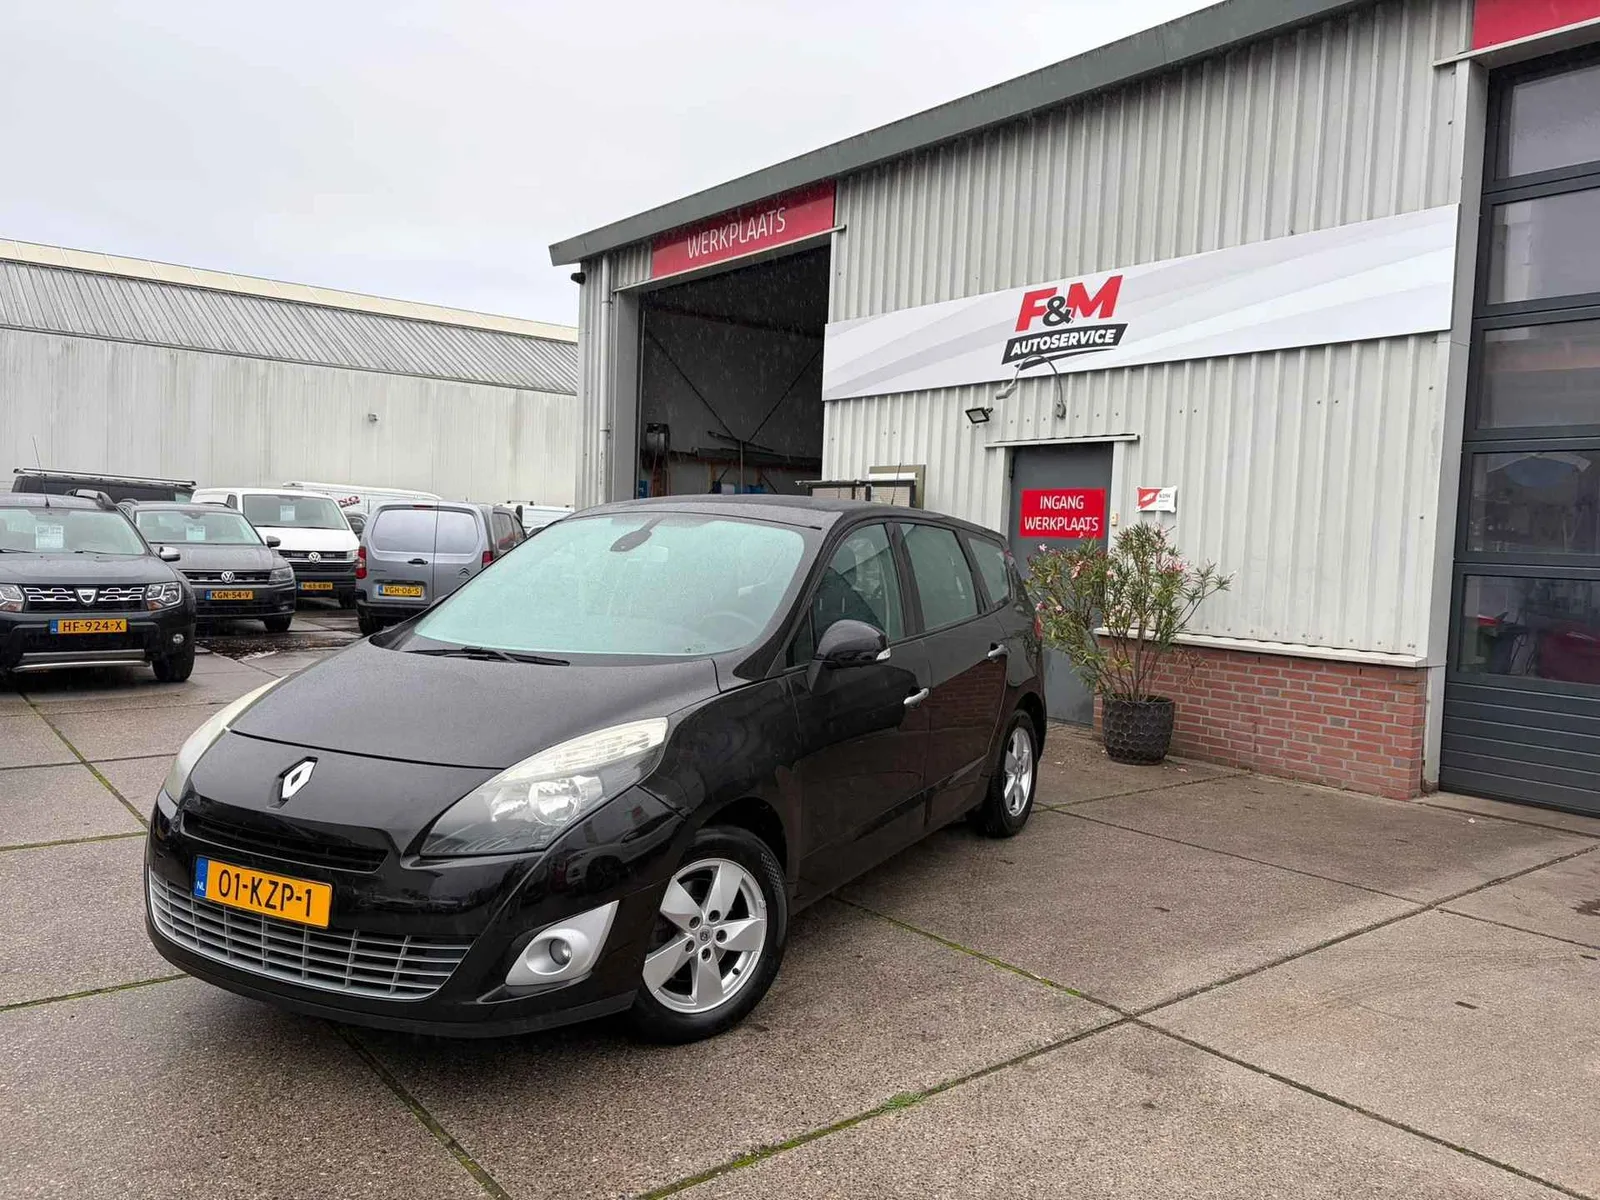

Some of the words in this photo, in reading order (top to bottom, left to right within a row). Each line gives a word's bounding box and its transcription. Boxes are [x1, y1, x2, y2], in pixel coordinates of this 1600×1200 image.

[687, 207, 786, 259] WERKPLAATS
[1014, 274, 1123, 332] F&M
[1010, 329, 1117, 356] AUTOSERVICE
[1040, 495, 1085, 510] INGANG
[1024, 516, 1099, 532] WERKPLAATS
[63, 621, 122, 632] HF-924-X
[196, 880, 206, 891] NL
[219, 869, 312, 917] 01-KZP-1
